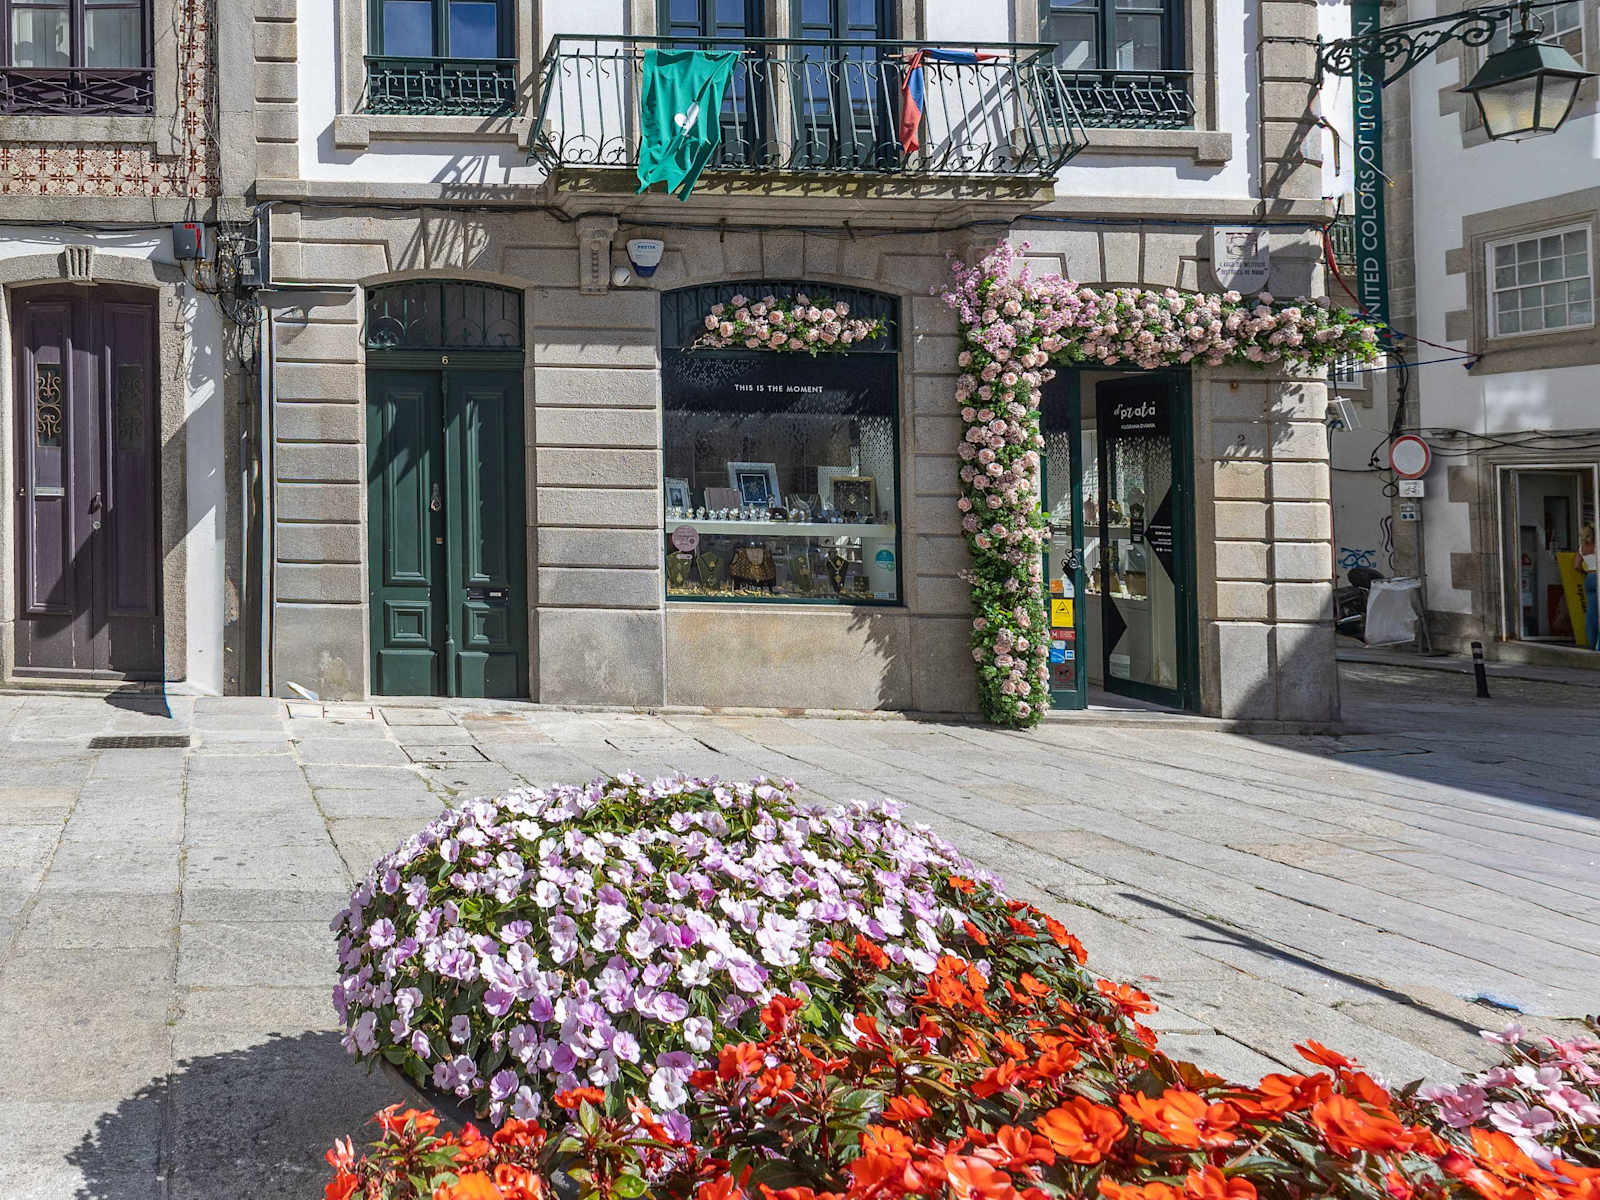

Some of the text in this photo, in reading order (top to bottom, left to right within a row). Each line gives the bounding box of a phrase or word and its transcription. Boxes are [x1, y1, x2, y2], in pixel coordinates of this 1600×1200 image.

[1360, 169, 1378, 251] COLORS
[1363, 258, 1382, 322] NITED
[168, 296, 173, 307] 8
[441, 355, 449, 365] 6
[734, 383, 824, 394] THIS IS THE MOMENT
[1237, 434, 1246, 447] 2
